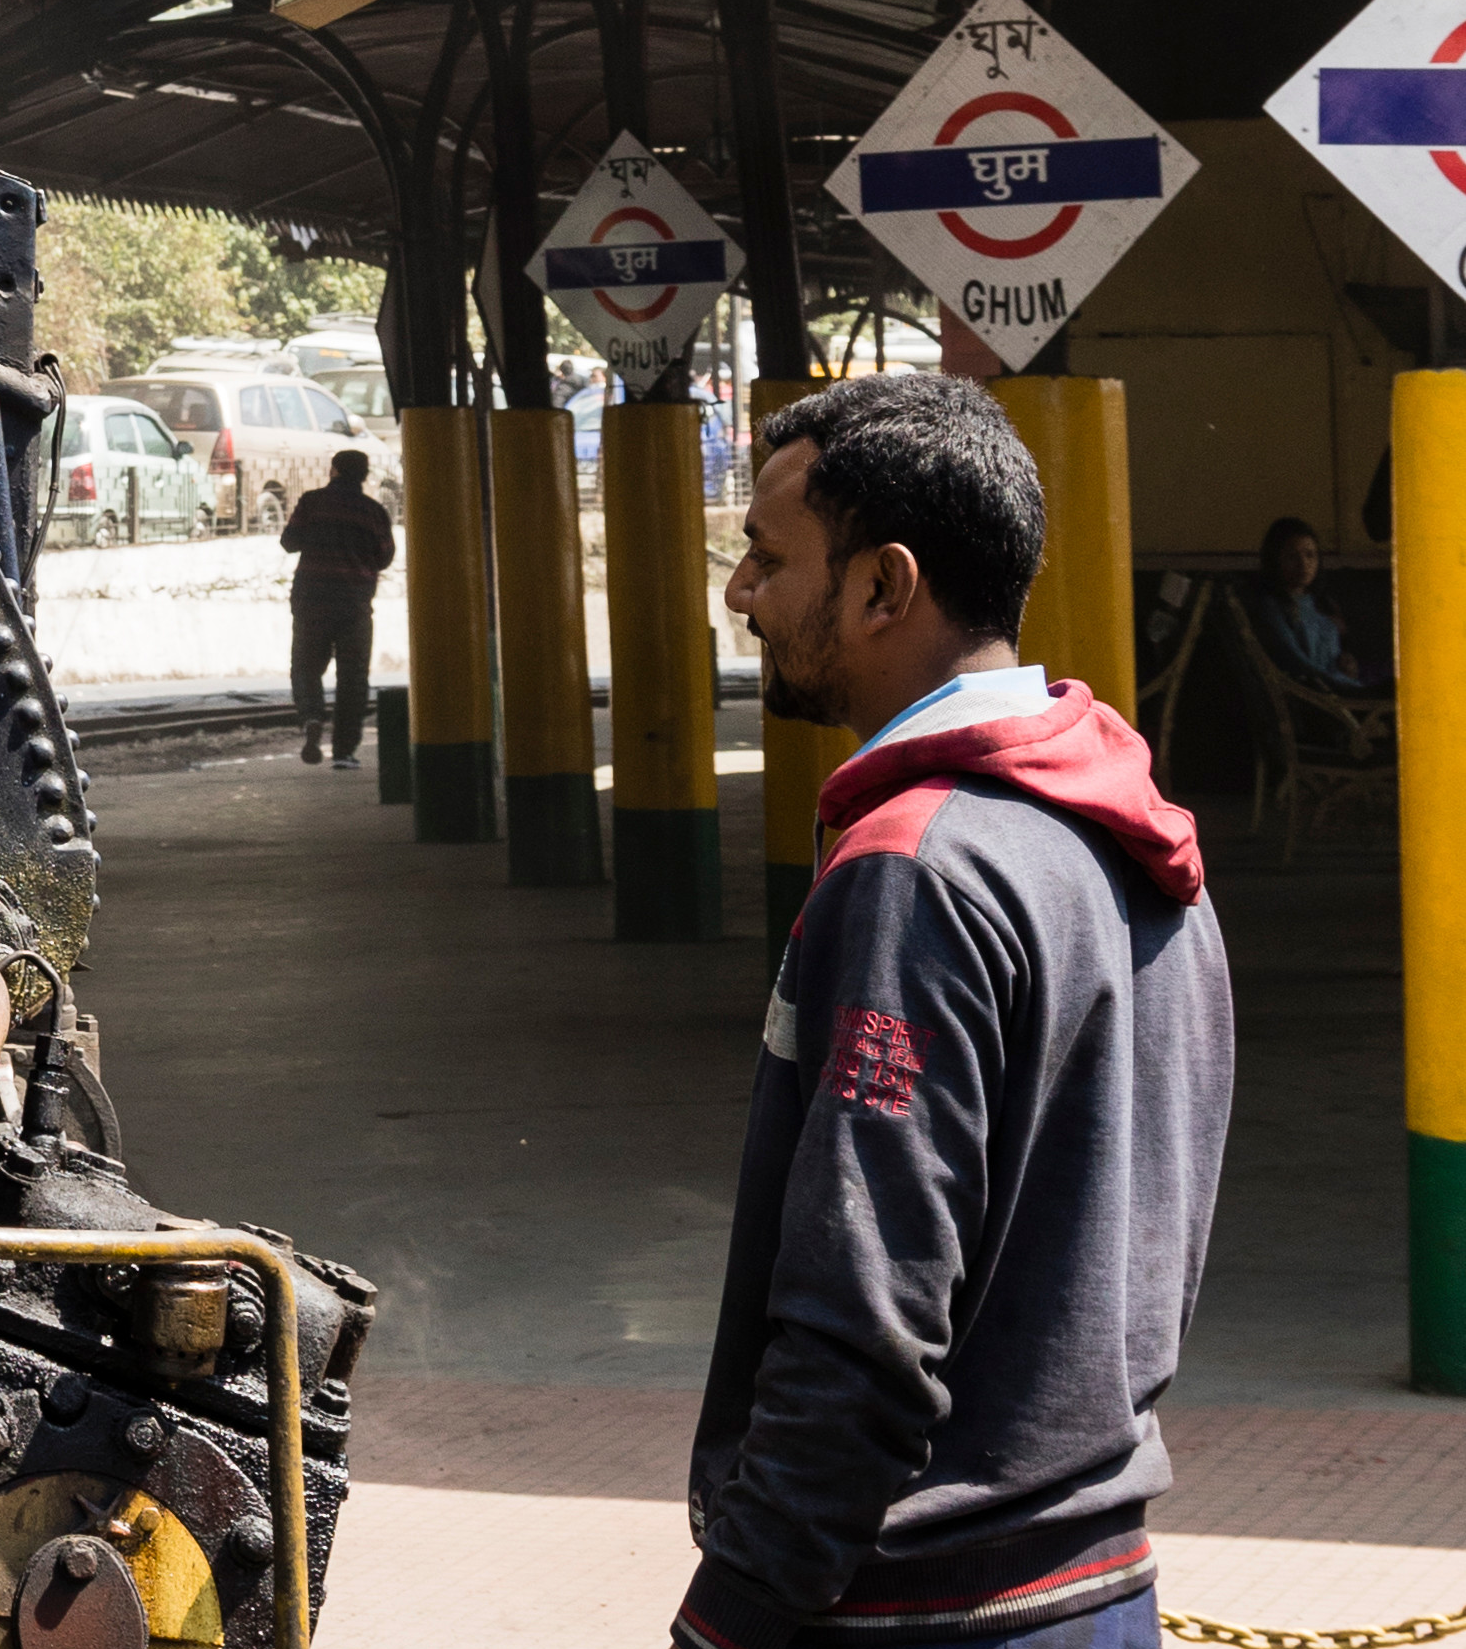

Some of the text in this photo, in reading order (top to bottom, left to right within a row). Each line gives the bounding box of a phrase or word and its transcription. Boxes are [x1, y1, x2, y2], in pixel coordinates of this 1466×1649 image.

[968, 148, 1050, 200] घुम
[609, 247, 659, 282] घुम
[963, 278, 1067, 327] GHUM
[863, 1010, 938, 1053] SPIRIT
